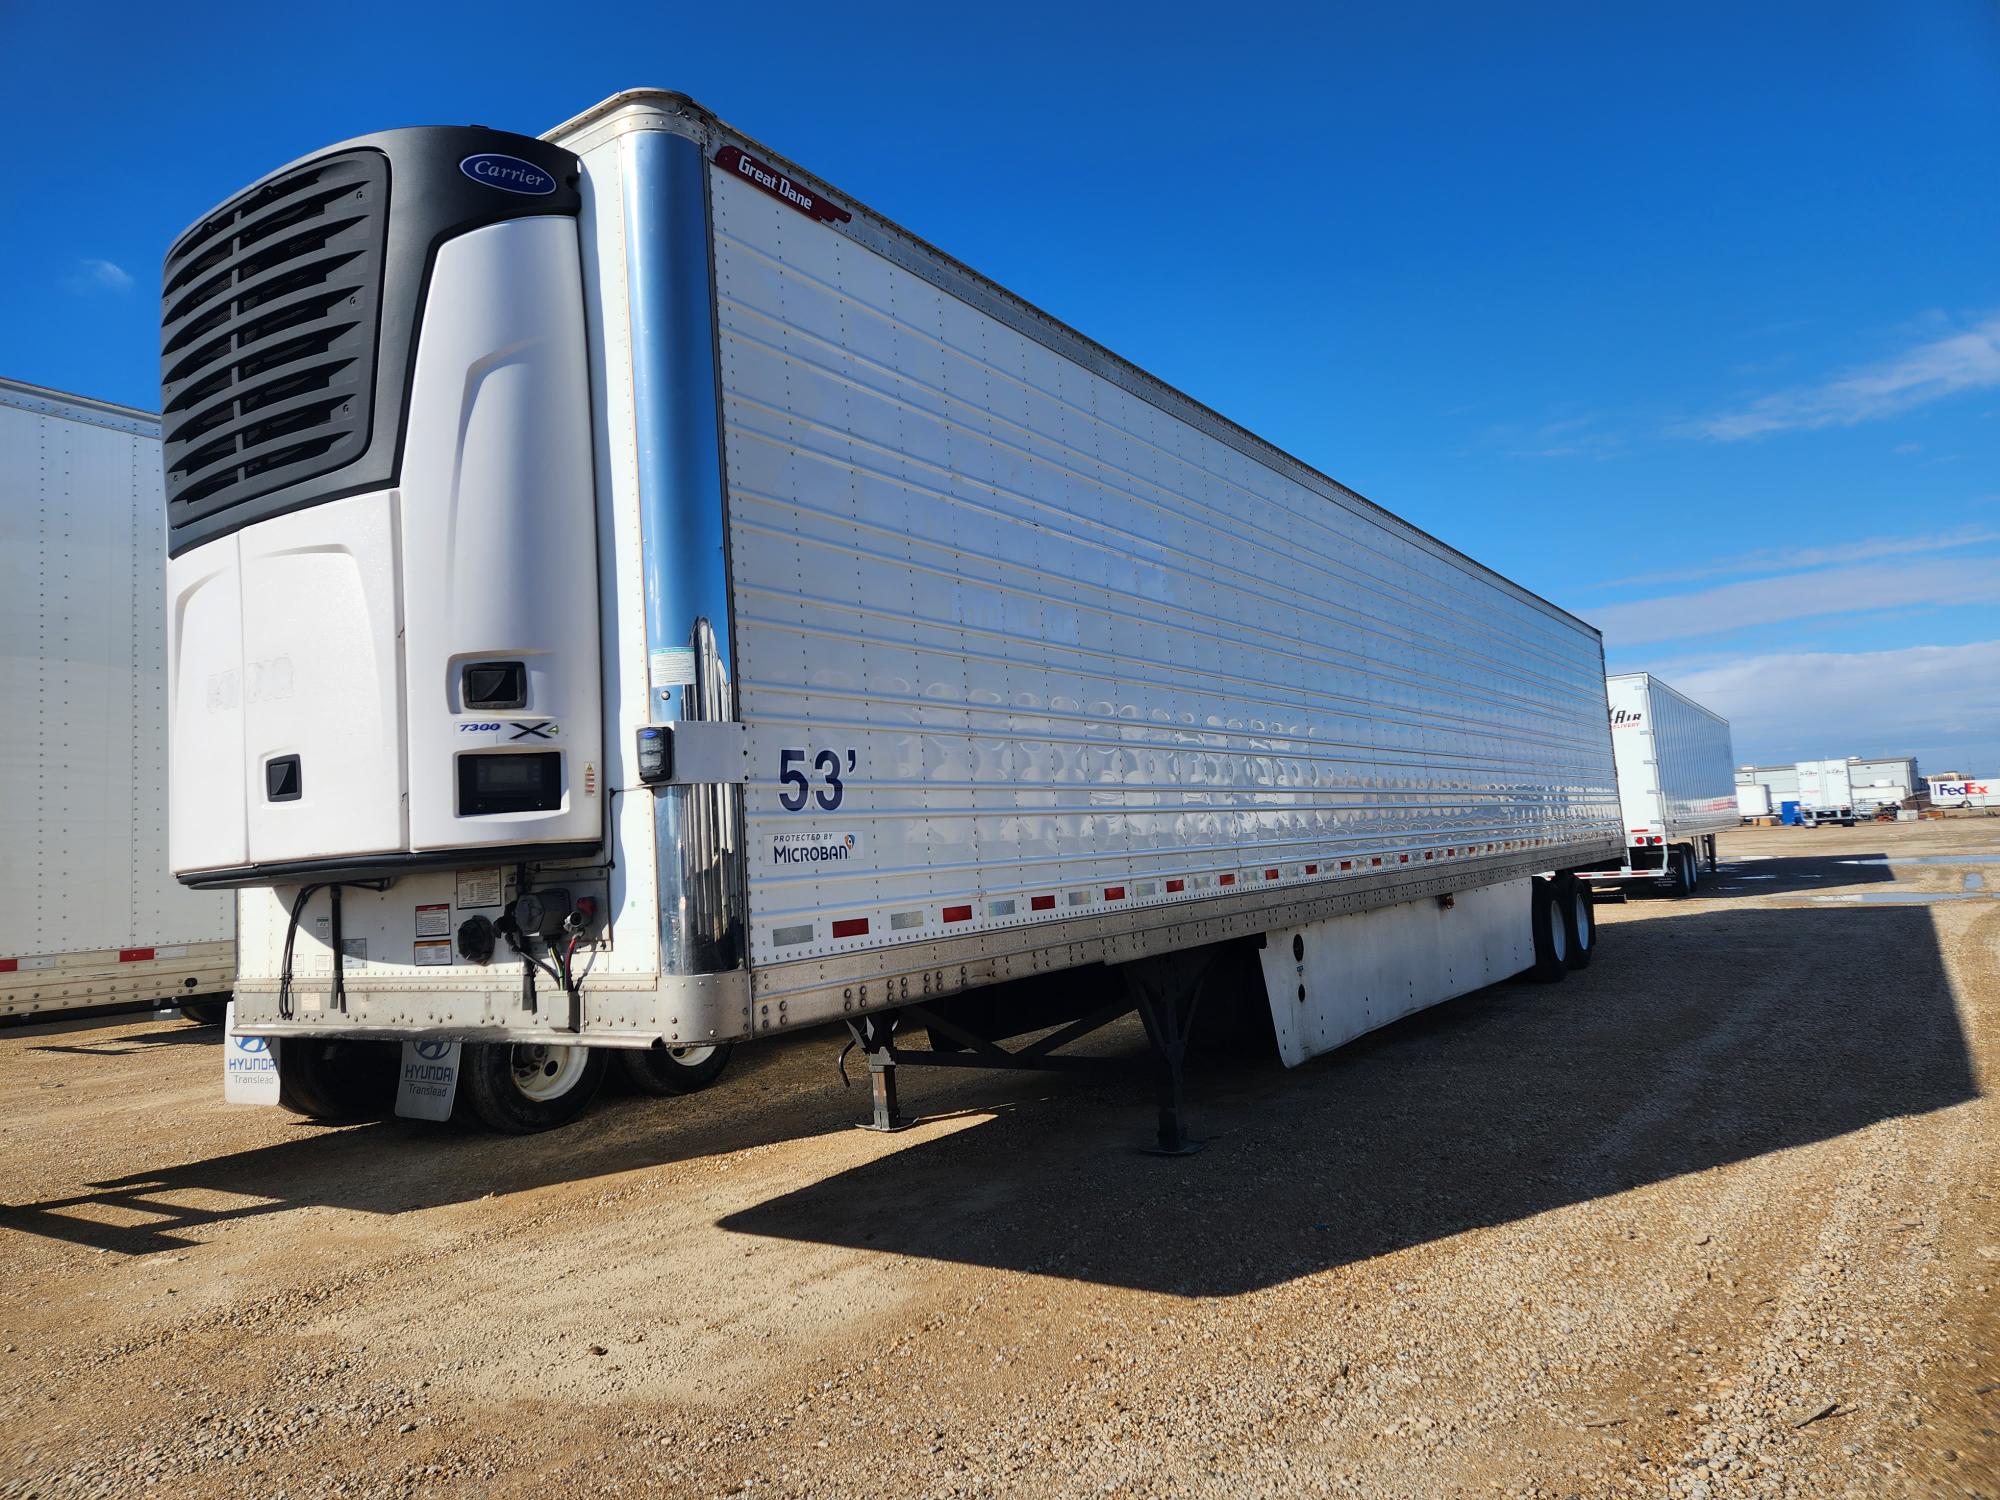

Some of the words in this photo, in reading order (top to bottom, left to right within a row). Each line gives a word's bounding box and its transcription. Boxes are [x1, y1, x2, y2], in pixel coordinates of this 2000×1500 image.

[474, 160, 545, 186] Carrier
[738, 155, 778, 190] Great
[778, 177, 812, 210] Dane
[459, 723, 501, 732] 7300
[1939, 782, 1989, 796] FedEx
[773, 833, 821, 842] PROTECTED
[229, 1058, 278, 1070] HYUNDAI
[234, 1074, 274, 1085] Translead
[404, 1063, 454, 1083] HYUNDAI
[408, 1083, 448, 1098] Translead
